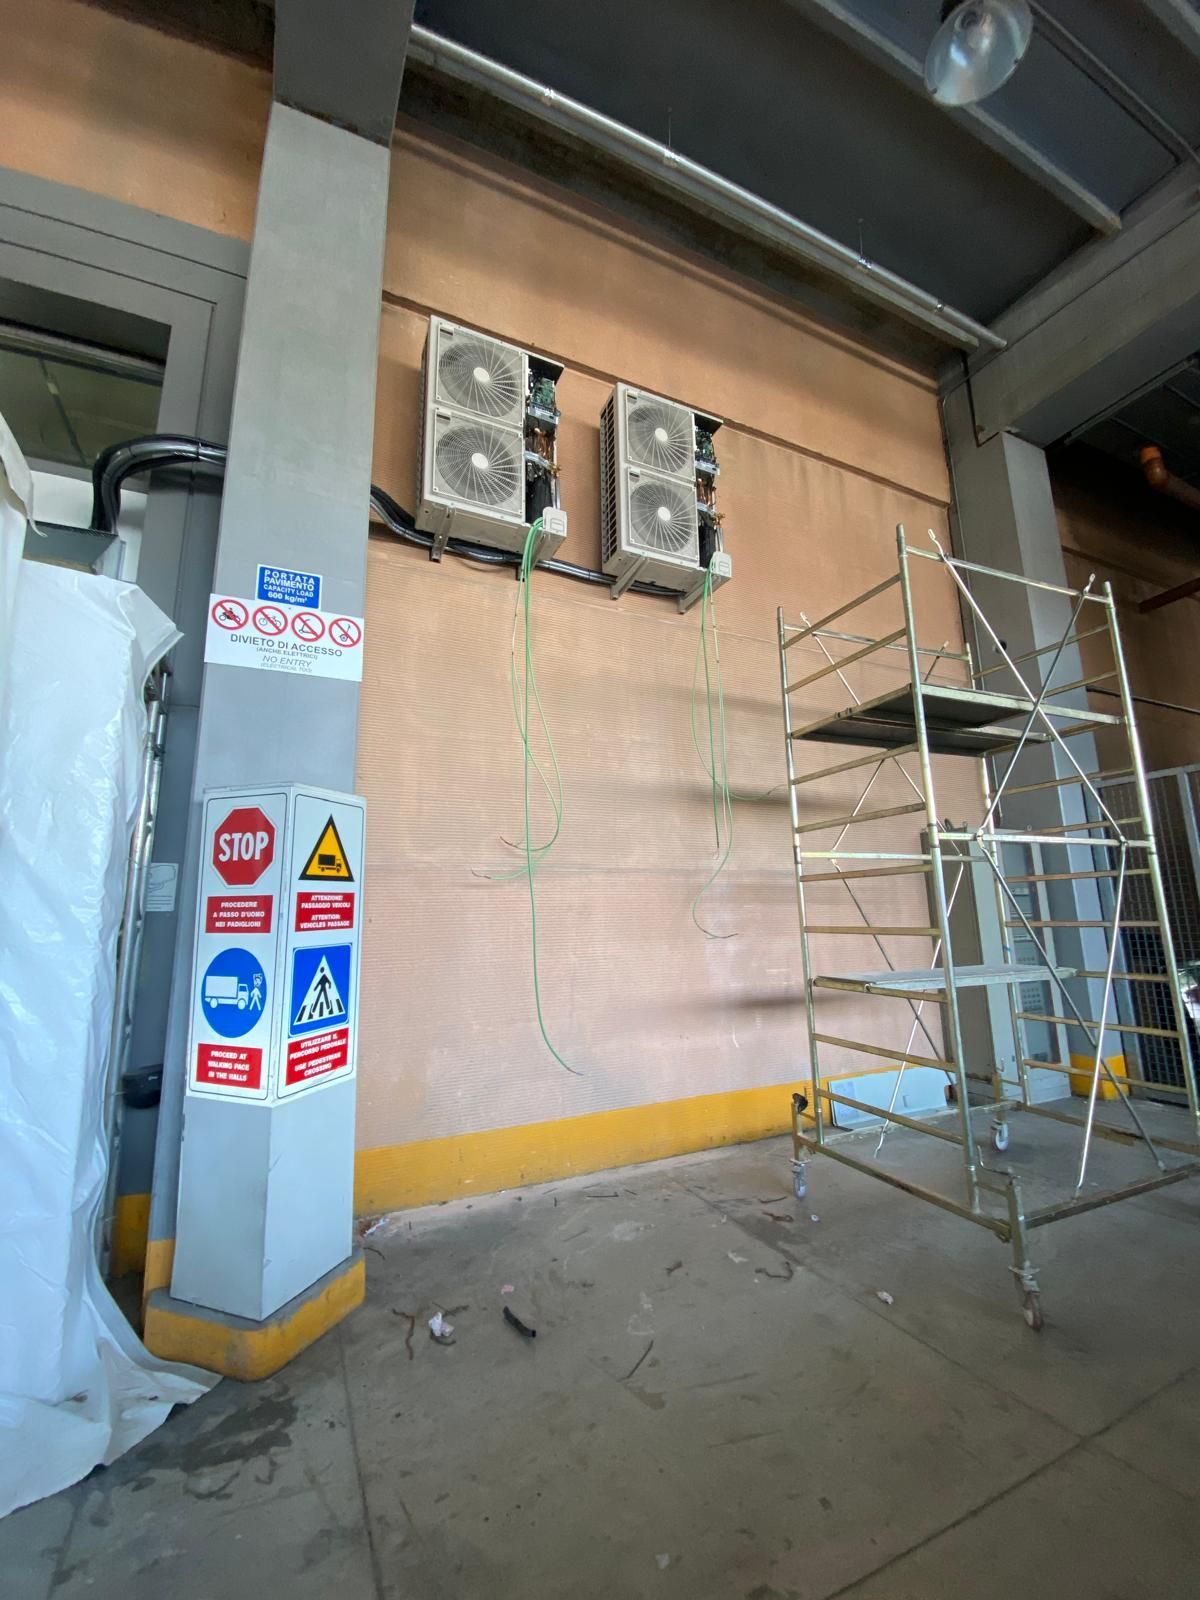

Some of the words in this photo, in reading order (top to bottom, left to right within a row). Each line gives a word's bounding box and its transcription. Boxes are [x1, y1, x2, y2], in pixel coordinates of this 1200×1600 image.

[264, 569, 315, 585] PORTATA
[264, 576, 315, 591] PAVIMENTO
[263, 584, 296, 595] CAPACITY
[296, 590, 314, 598] LOAD
[267, 591, 283, 600] 600
[230, 633, 275, 648] DIVIETO
[278, 641, 289, 650] DI
[290, 643, 343, 657] ACCESSO
[256, 647, 282, 655] (ANCHE
[283, 650, 318, 660] ELETTRICI)
[262, 655, 278, 663] NO
[279, 657, 312, 668] ENTRY
[218, 831, 269, 862] STOP
[299, 921, 326, 929] VEHICLES
[300, 1034, 332, 1049] UTILIZZARE
[332, 1032, 339, 1040] IL
[210, 1050, 238, 1059] PROCEED
[289, 1046, 320, 1060] PERCORSO
[320, 1037, 347, 1051] PEDONALE
[207, 1060, 233, 1069] WALKING
[233, 1063, 250, 1071] PACE
[294, 1061, 307, 1072] USE
[307, 1051, 342, 1068] PEDESTRIAN
[215, 1071, 228, 1079] THE
[228, 1073, 248, 1082] HALLS
[303, 1062, 333, 1077] CROSSING
